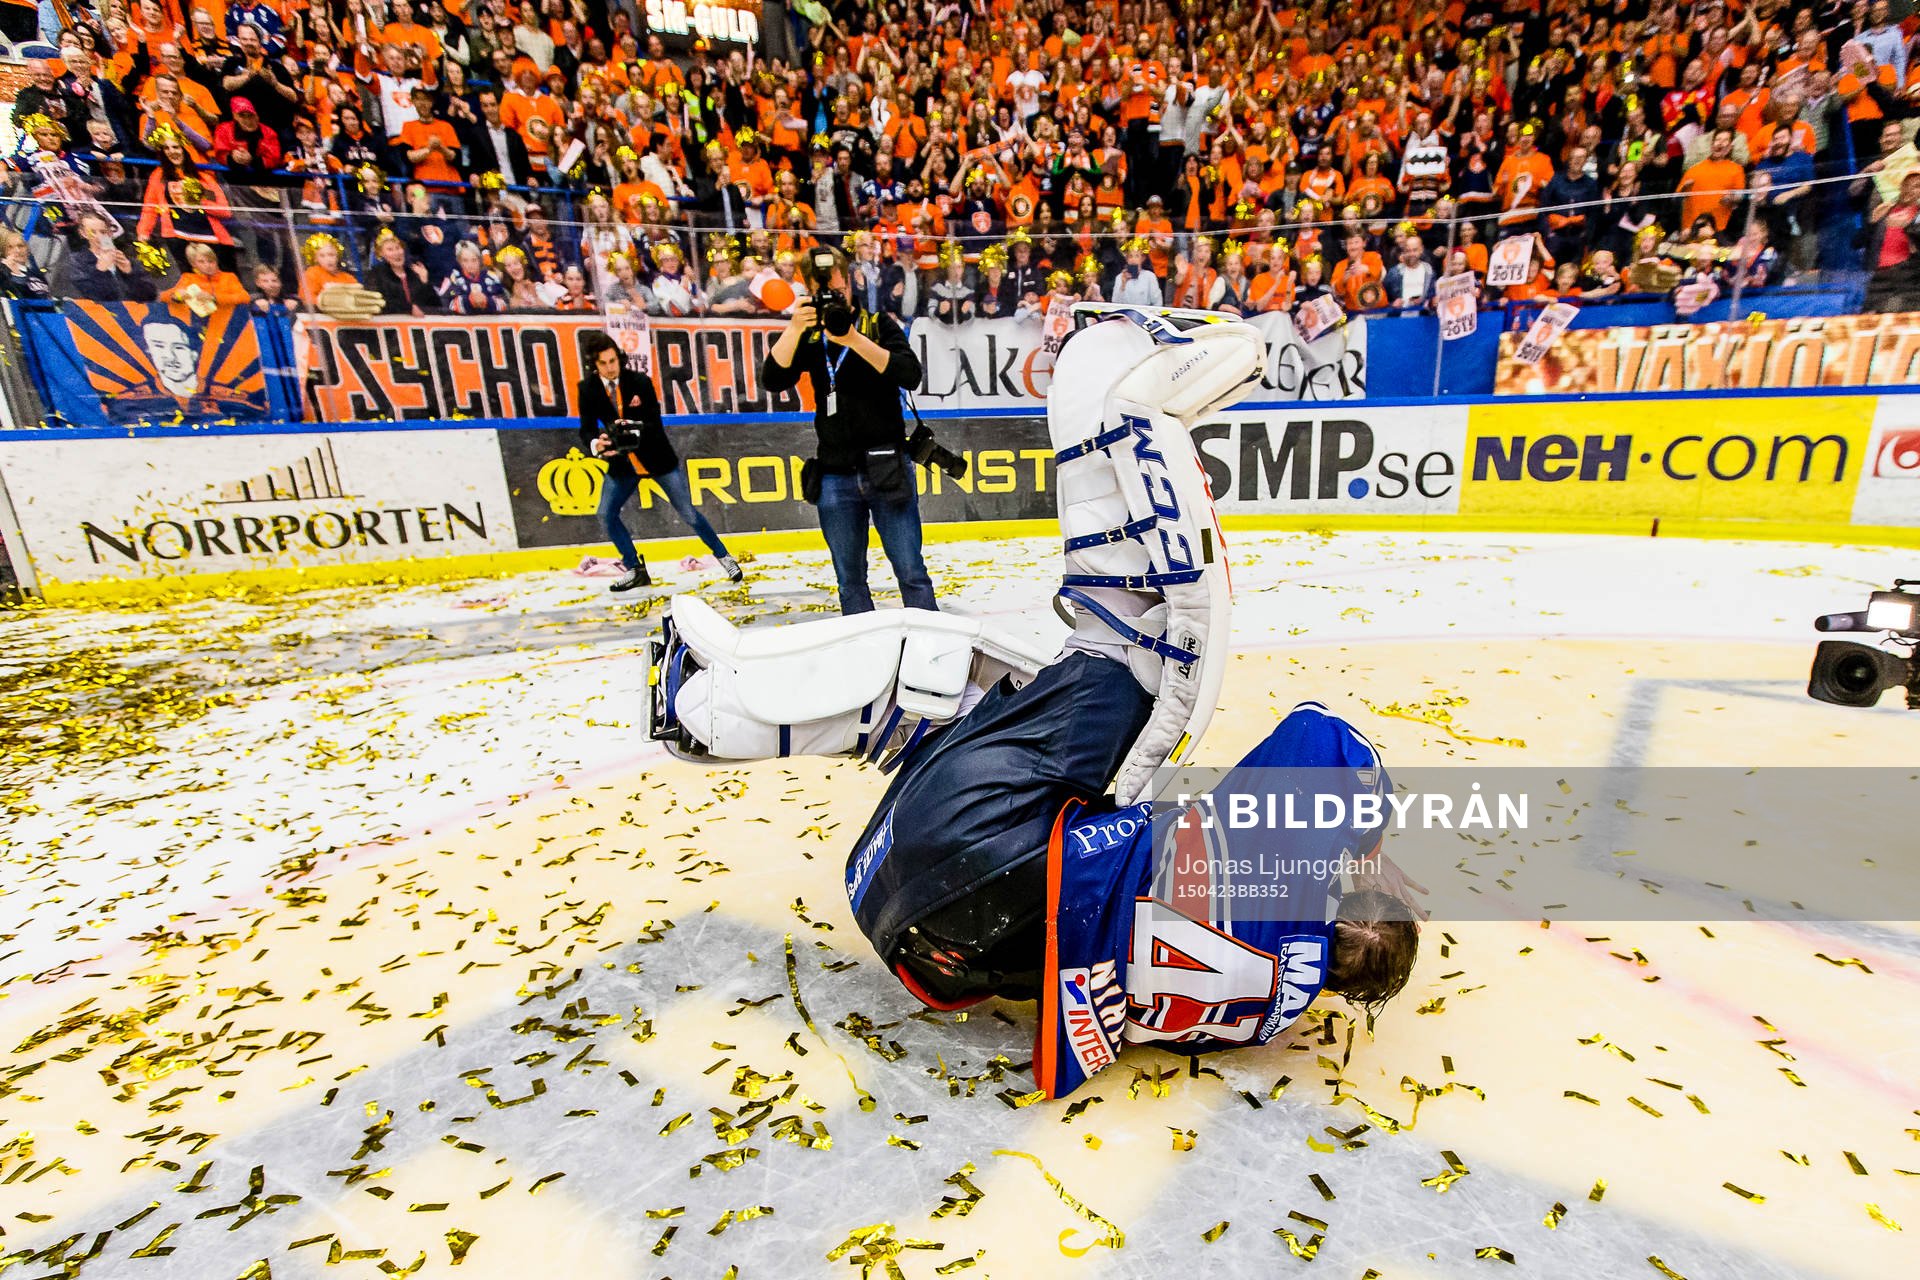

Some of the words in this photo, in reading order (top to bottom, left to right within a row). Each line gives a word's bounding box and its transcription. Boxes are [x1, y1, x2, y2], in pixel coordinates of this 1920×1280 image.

[305, 327, 568, 422] PSYCHO
[1044, 341, 1058, 353] 20
[81, 501, 488, 564] NORRPORTEN
[1090, 959, 1126, 1053] NIHL
